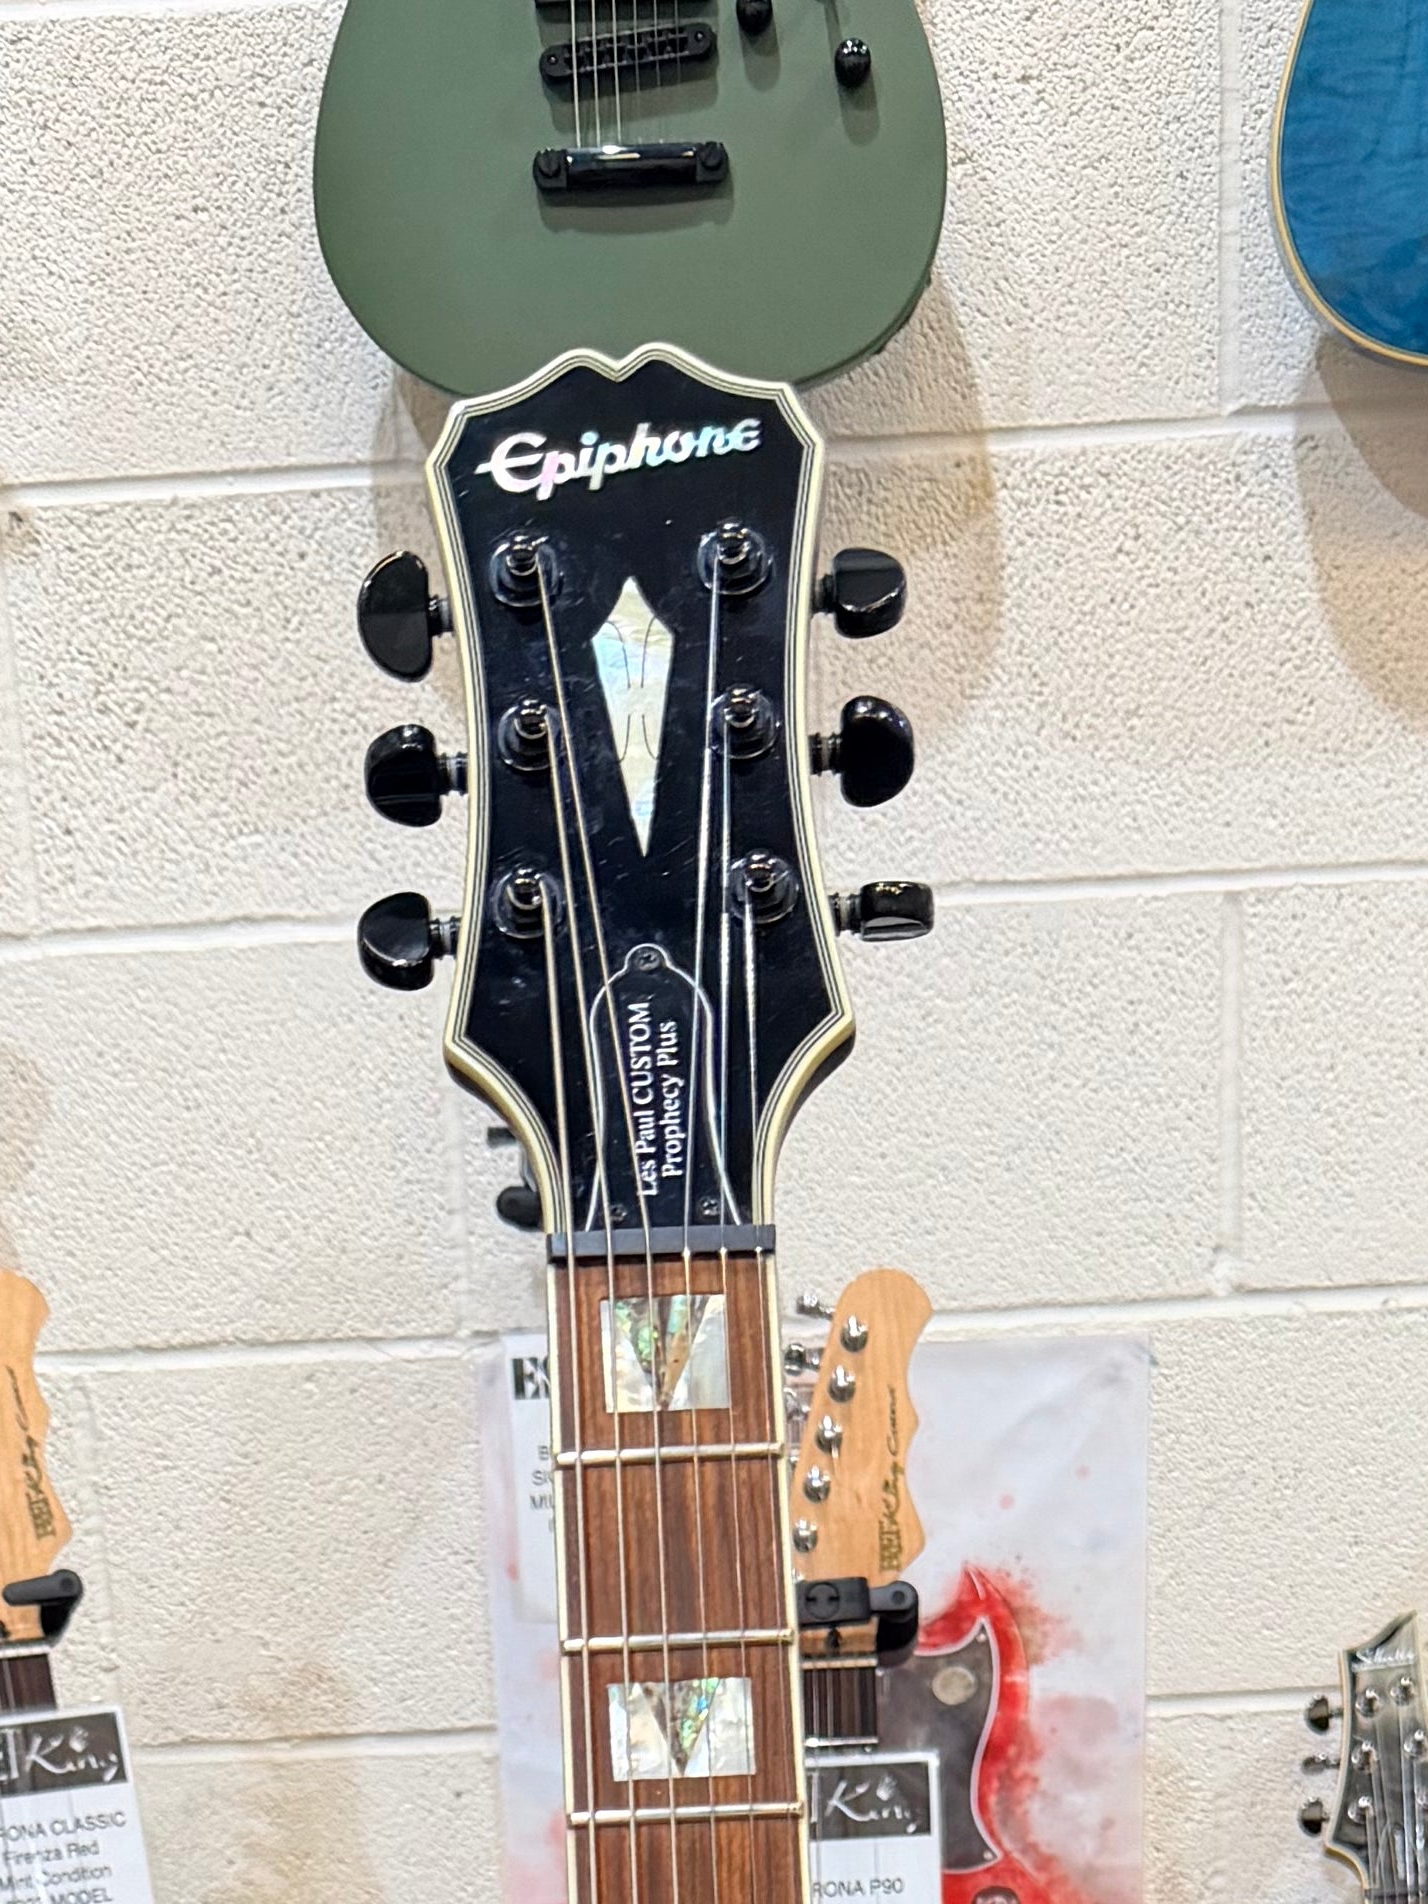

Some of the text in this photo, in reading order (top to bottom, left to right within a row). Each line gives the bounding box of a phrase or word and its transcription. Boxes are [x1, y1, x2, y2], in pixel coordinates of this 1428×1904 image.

[475, 417, 762, 501] Epiphone
[628, 1003, 659, 1196] Les Paul CUSTOM
[656, 1020, 685, 1178] Prophecy Plus
[49, 1811, 126, 1837] CLASSIC
[67, 1840, 100, 1858] Red
[813, 1877, 904, 1898] RONA P90
